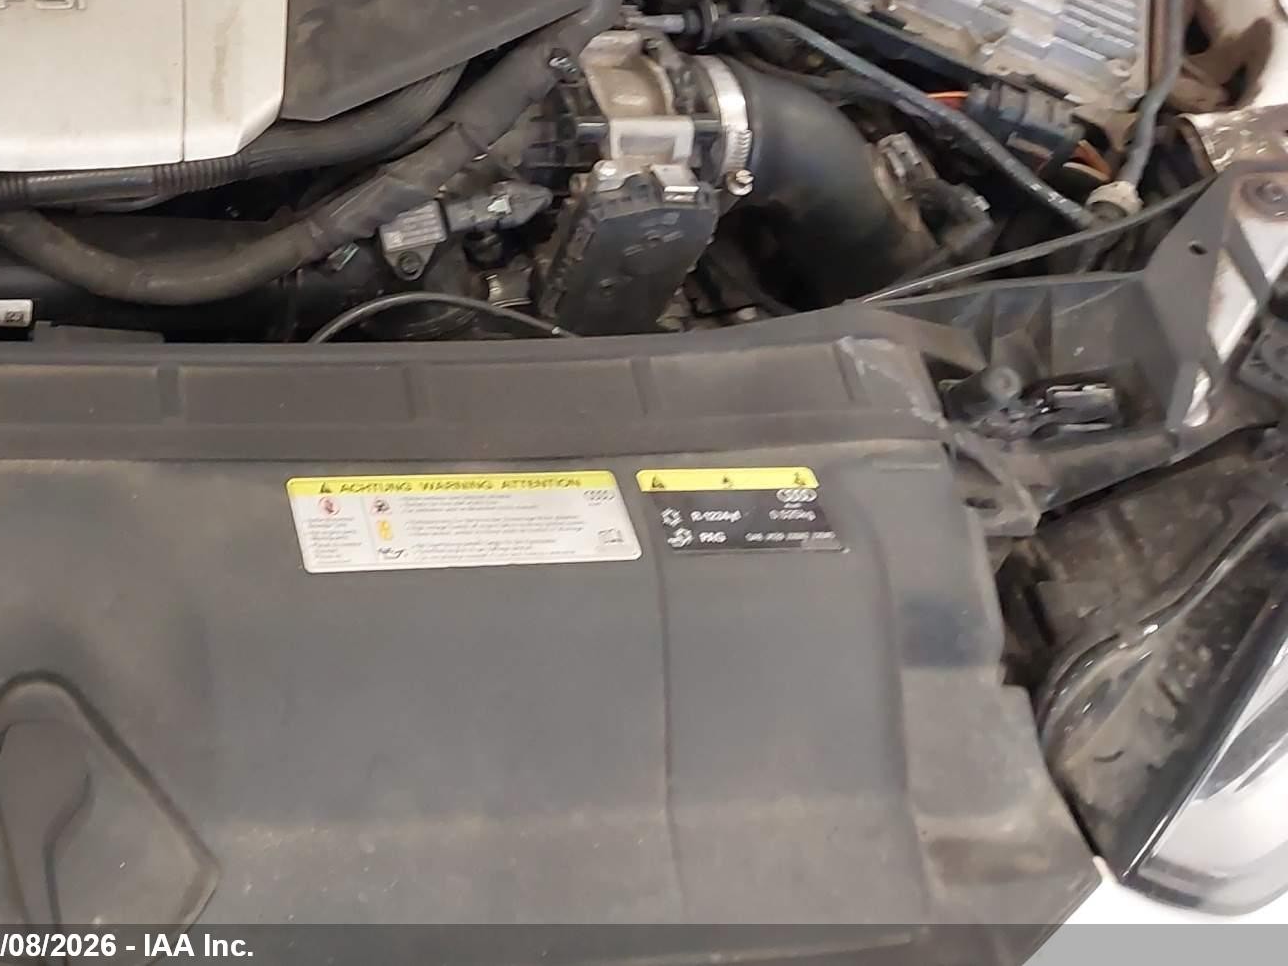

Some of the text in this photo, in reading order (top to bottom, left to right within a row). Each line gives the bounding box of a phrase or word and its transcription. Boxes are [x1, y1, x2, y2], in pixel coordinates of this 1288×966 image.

[339, 478, 582, 494] ACHTUNG WARNING ATTENTION
[698, 531, 728, 545] PAG
